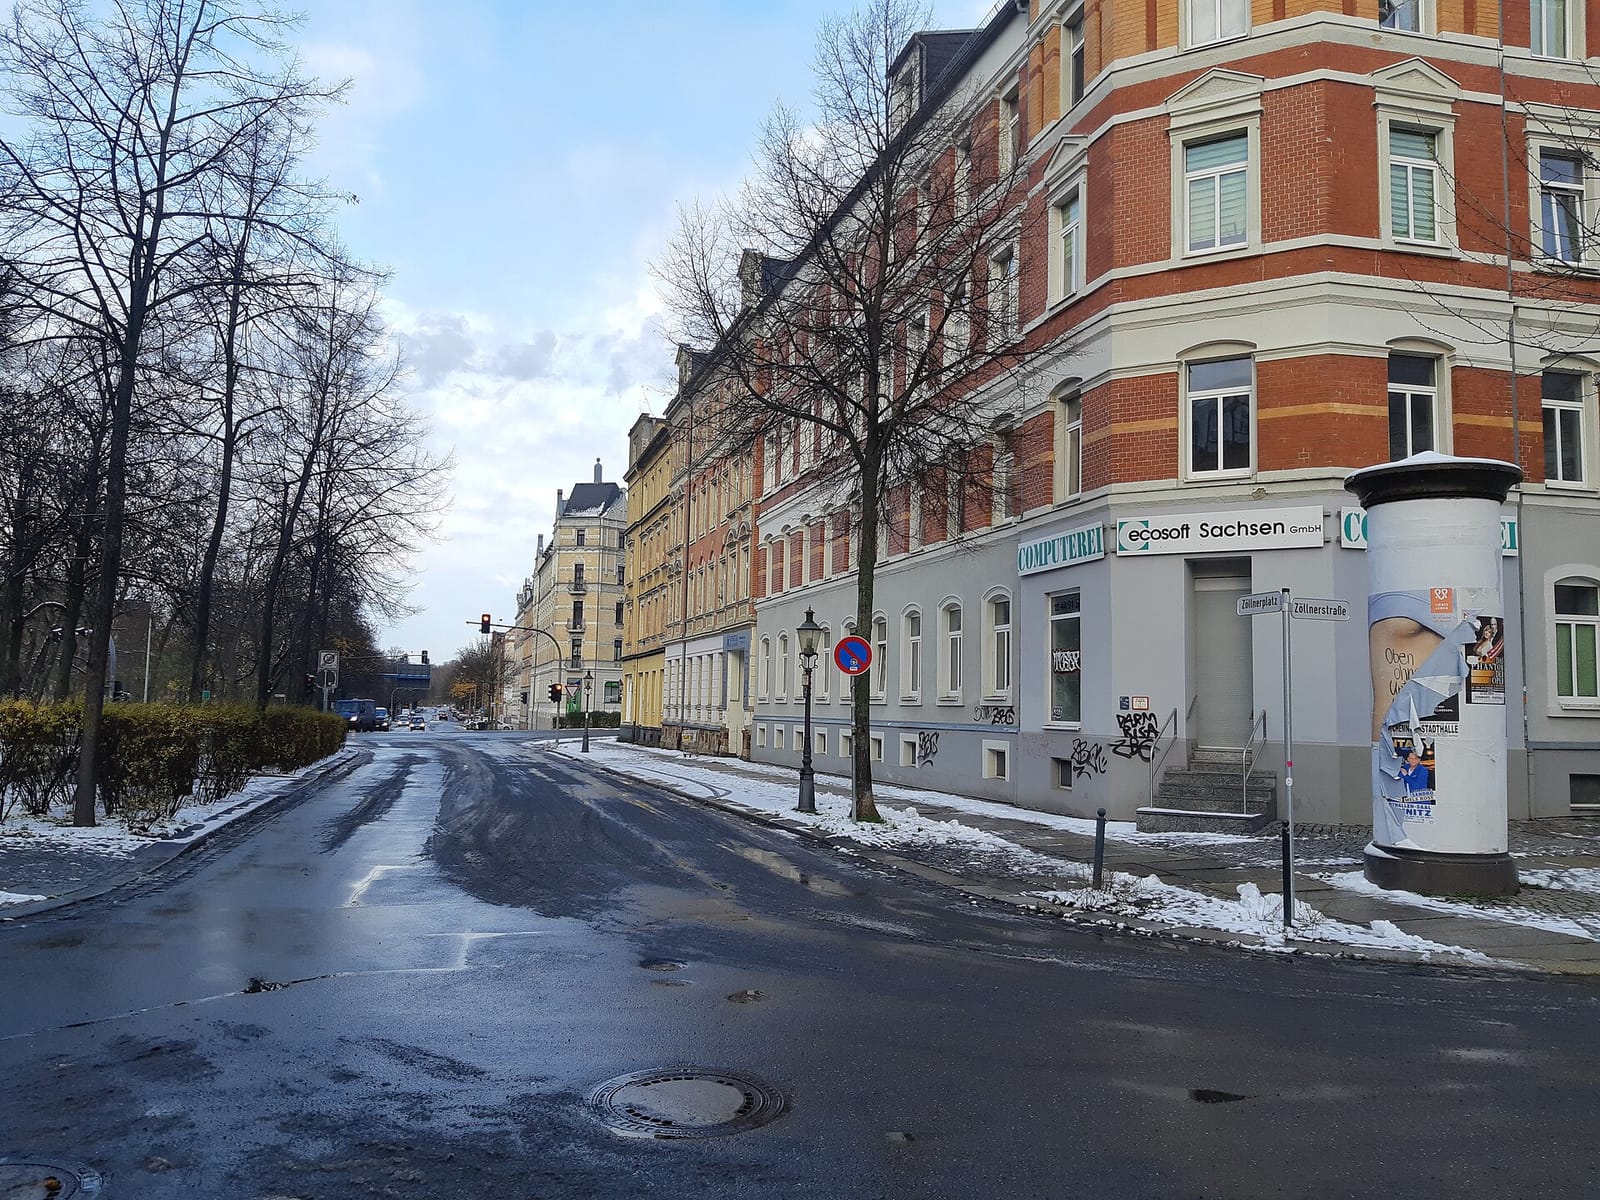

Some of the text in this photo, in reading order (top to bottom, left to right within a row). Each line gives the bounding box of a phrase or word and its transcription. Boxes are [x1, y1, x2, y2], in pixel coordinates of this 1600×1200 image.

[1128, 523, 1191, 542] ecosoft
[1199, 520, 1285, 539] Sachsen
[1289, 524, 1322, 534] GmbH
[1018, 526, 1103, 572] COMPUTEREI
[1241, 596, 1278, 610] Zöllnerplatz
[1294, 602, 1347, 616] Zöllnerstraße
[1385, 647, 1414, 665] Oben
[1394, 663, 1416, 681] ohn
[1420, 724, 1459, 733] STADTHALLE
